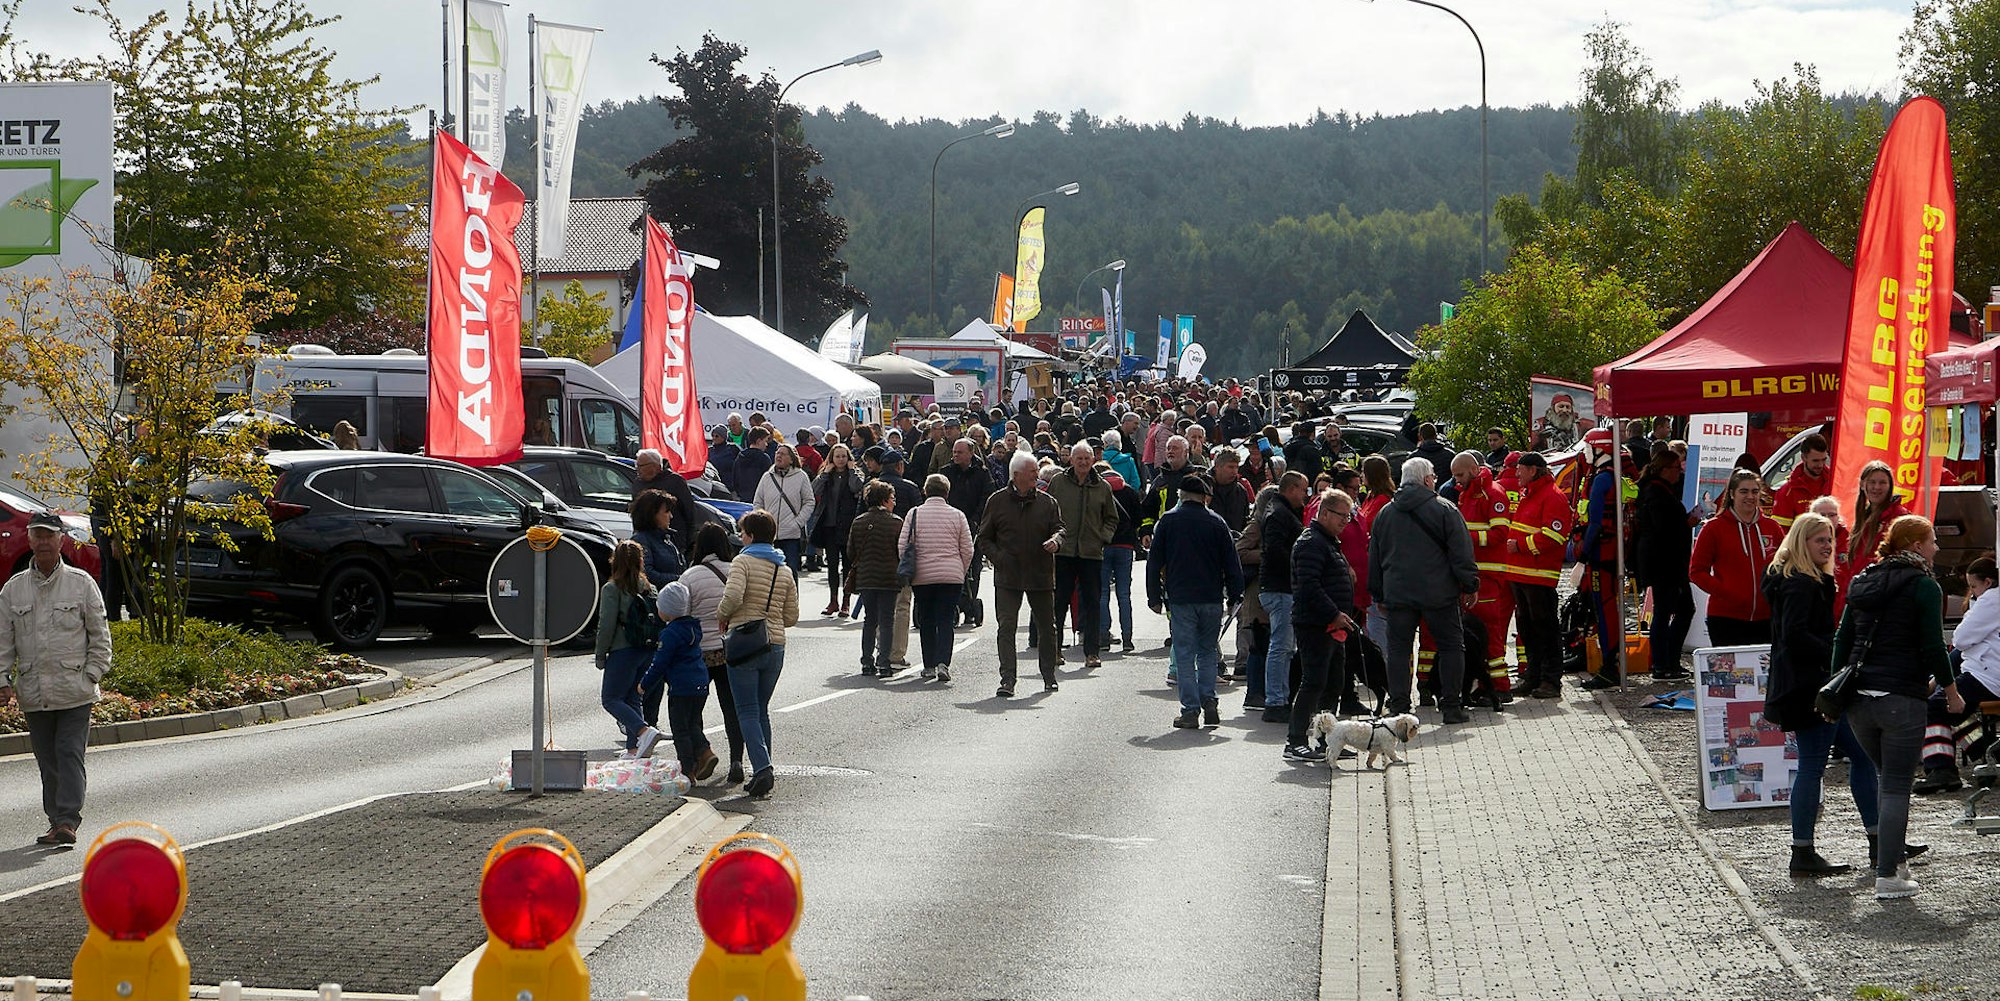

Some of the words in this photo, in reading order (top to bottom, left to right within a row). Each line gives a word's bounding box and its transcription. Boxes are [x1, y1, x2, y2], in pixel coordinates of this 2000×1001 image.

[0, 120, 60, 145] ETZ
[543, 95, 558, 188] PEETZ
[7, 148, 28, 156] UND
[30, 146, 60, 156] TÜREN
[1864, 276, 1899, 450] DLRG
[1702, 375, 1806, 399] DLRG
[796, 401, 818, 414] eG
[1702, 423, 1744, 437] DLRG
